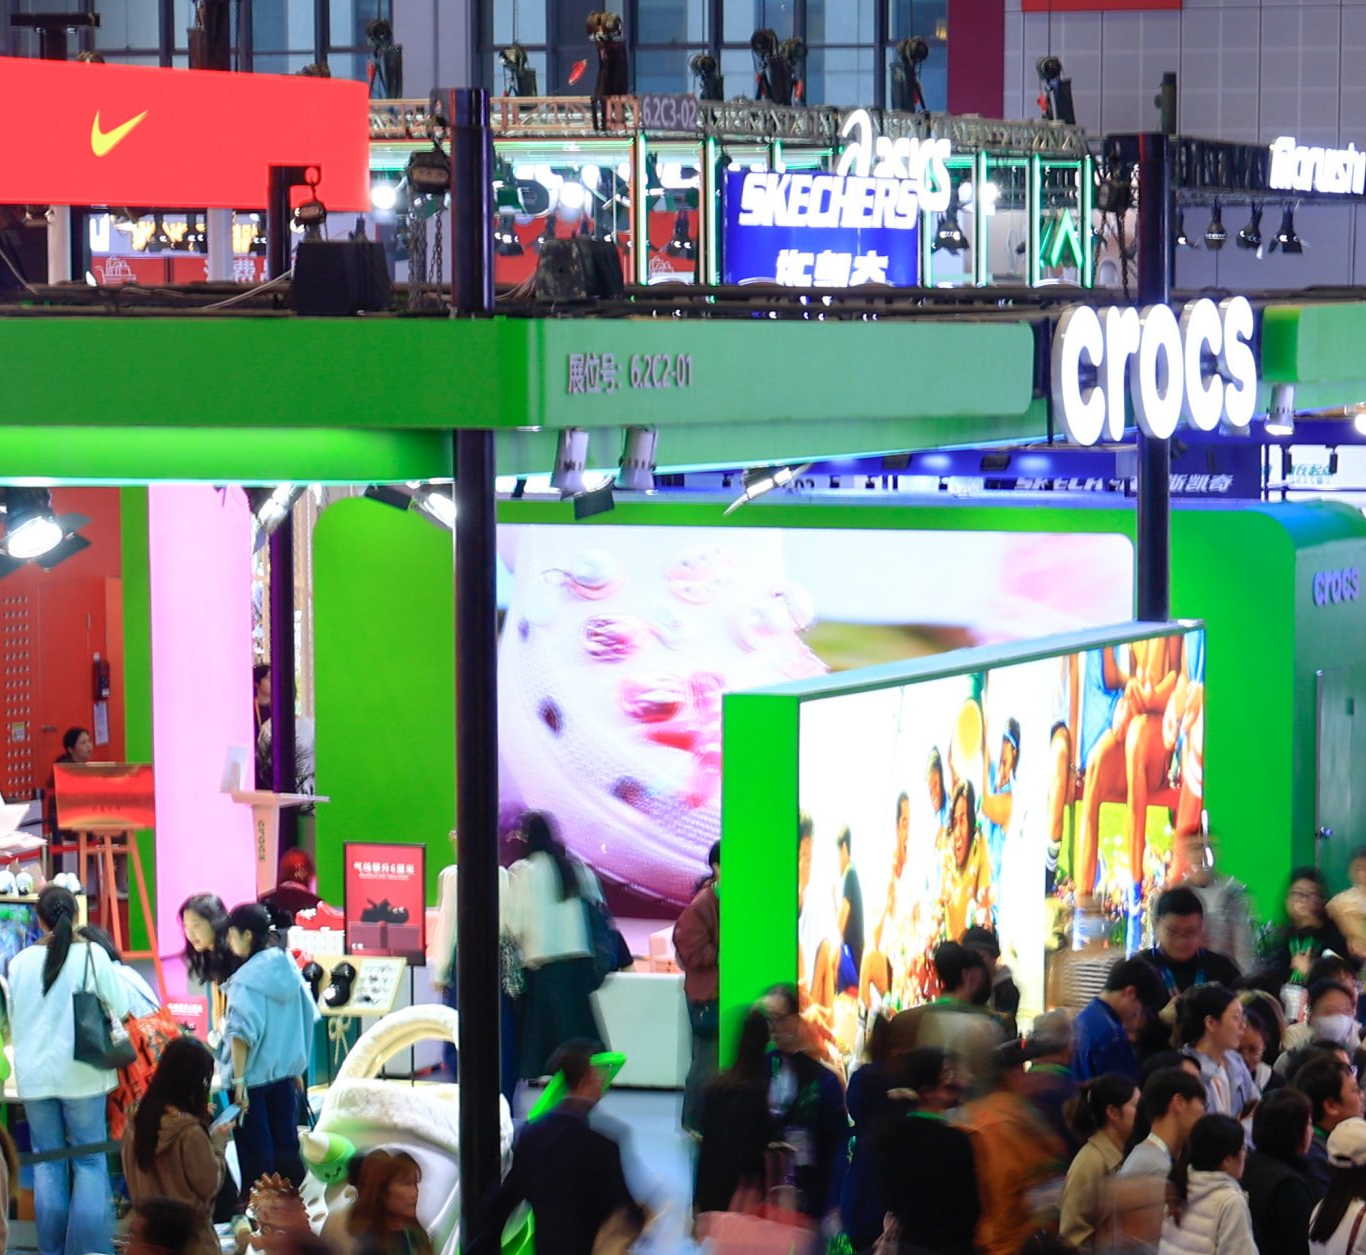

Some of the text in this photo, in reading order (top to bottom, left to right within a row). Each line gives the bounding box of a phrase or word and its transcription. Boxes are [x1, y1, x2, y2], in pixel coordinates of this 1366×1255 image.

[738, 173, 920, 230] SKECHERS
[630, 353, 693, 388] 6.2C2-01
[1053, 296, 1257, 446] crocs
[1312, 565, 1361, 608] crocs
[257, 819, 267, 863] crocs
